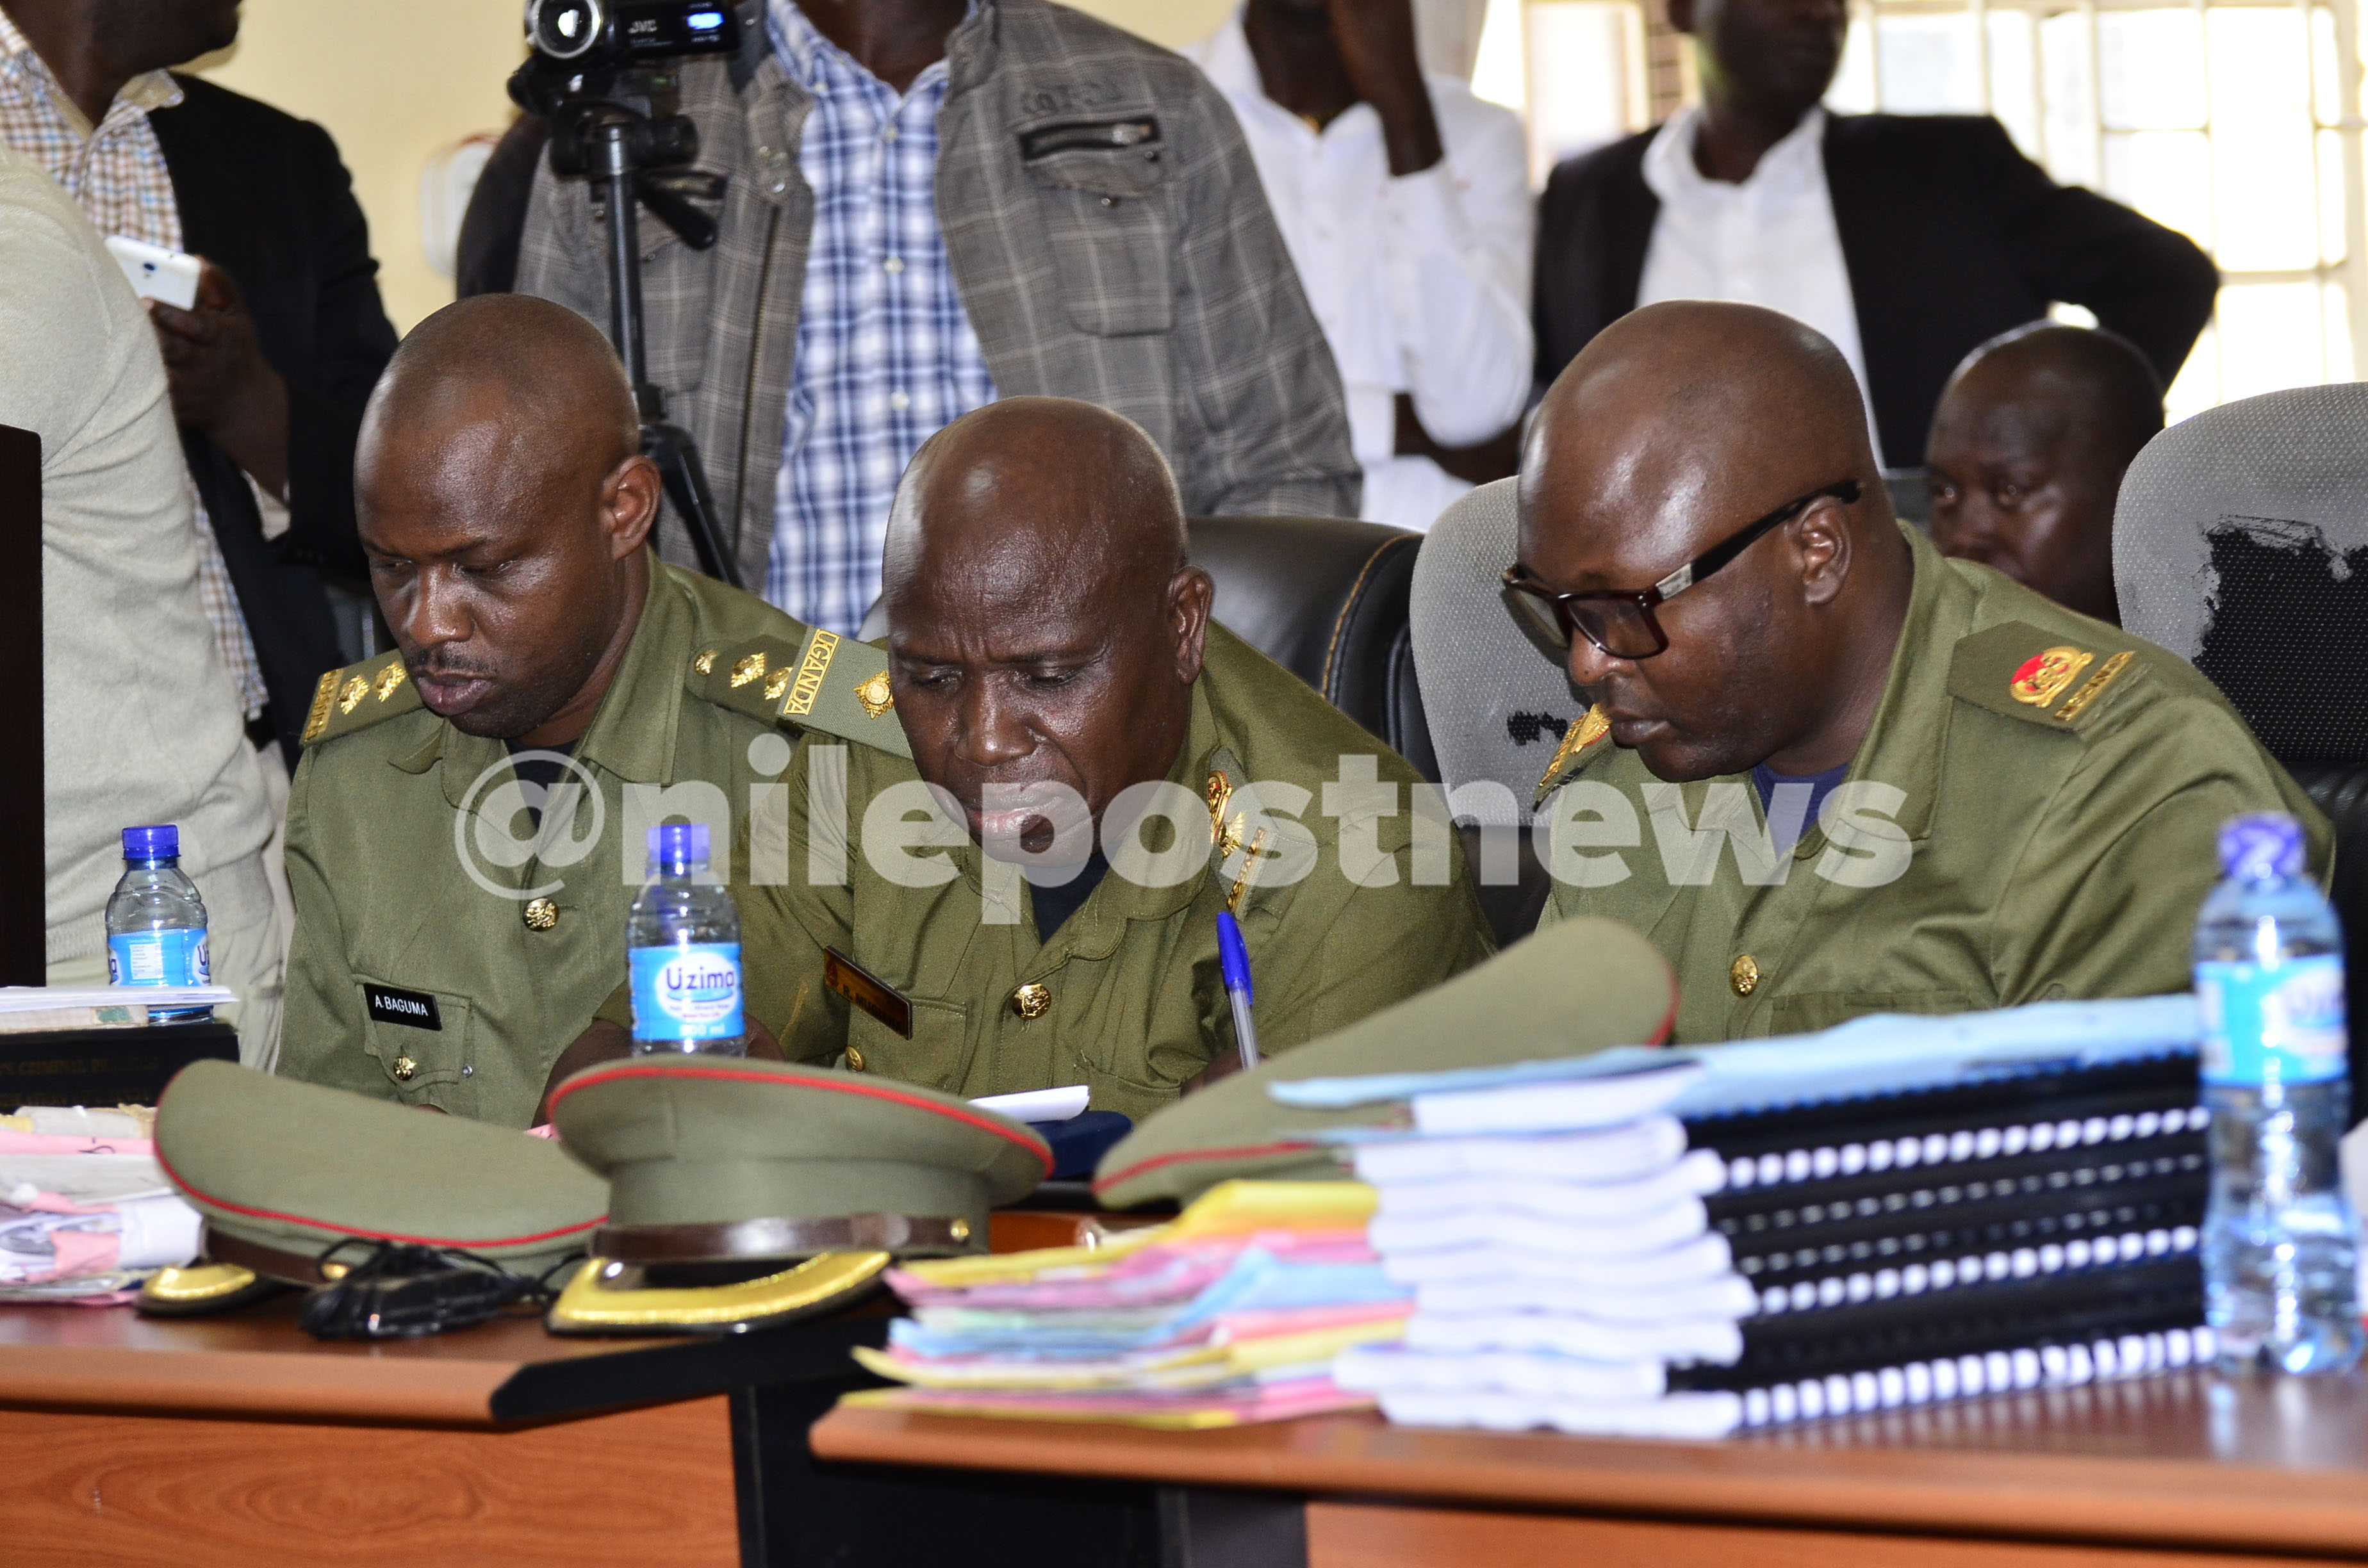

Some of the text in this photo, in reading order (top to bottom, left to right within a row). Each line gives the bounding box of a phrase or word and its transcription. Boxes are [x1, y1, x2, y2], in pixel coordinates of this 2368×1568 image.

[784, 629, 839, 715] UGANDA
[666, 966, 734, 990] Uzima
[384, 996, 429, 1017] BAGUMA
